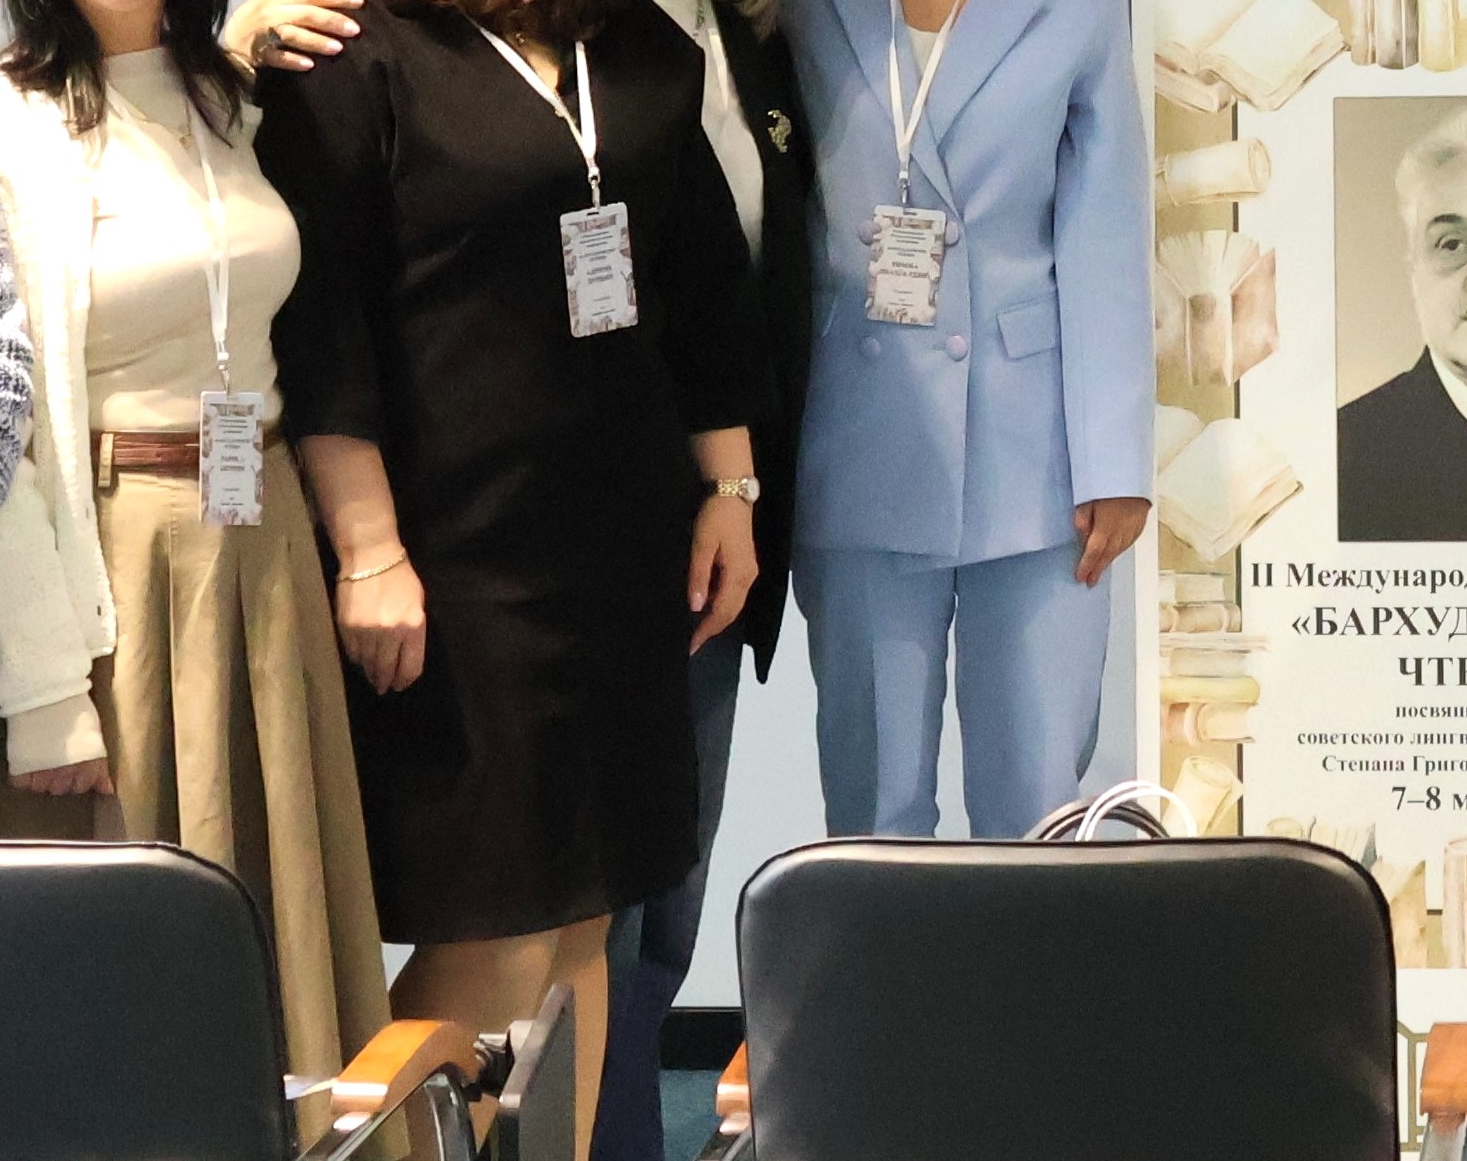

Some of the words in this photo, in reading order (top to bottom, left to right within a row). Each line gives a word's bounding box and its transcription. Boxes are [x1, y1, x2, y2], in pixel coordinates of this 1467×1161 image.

[1251, 562, 1274, 588] II
[1297, 733, 1405, 745] советского
[1321, 755, 1406, 772] Степана
